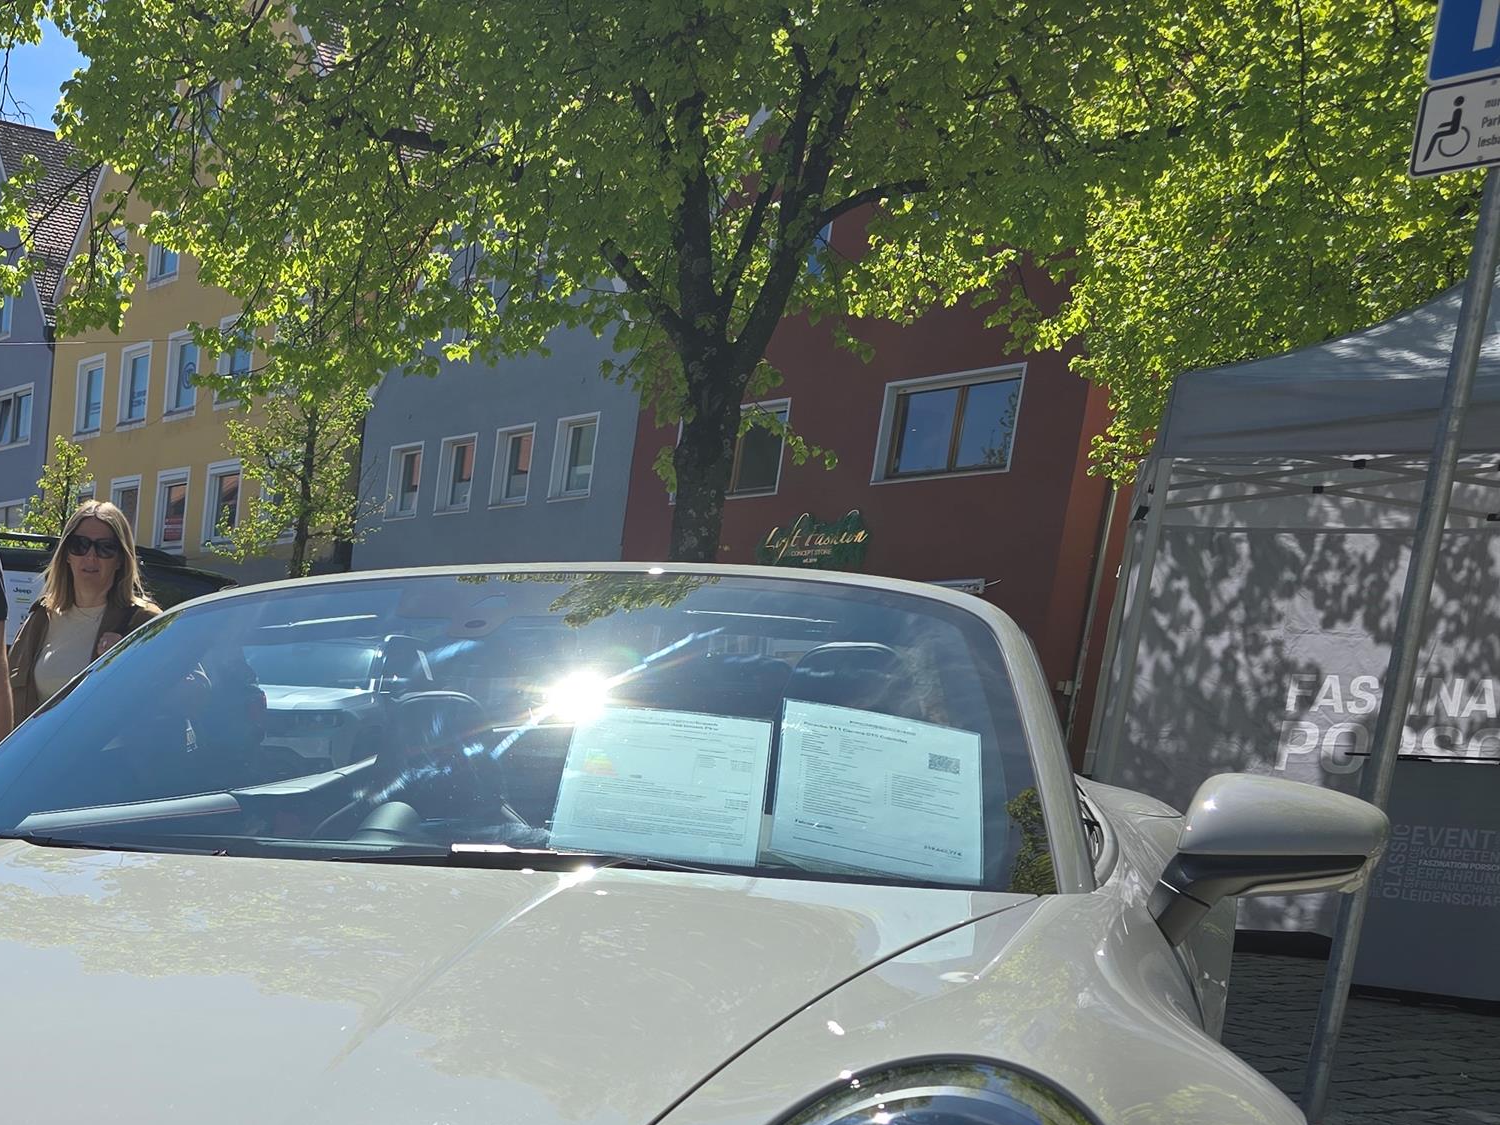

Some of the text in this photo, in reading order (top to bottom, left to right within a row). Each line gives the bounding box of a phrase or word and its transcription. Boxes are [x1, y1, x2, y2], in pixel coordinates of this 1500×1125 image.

[1285, 674, 1497, 718] FASINA
[1411, 825, 1497, 850] EVENT
[1383, 824, 1410, 899] CLASSIC
